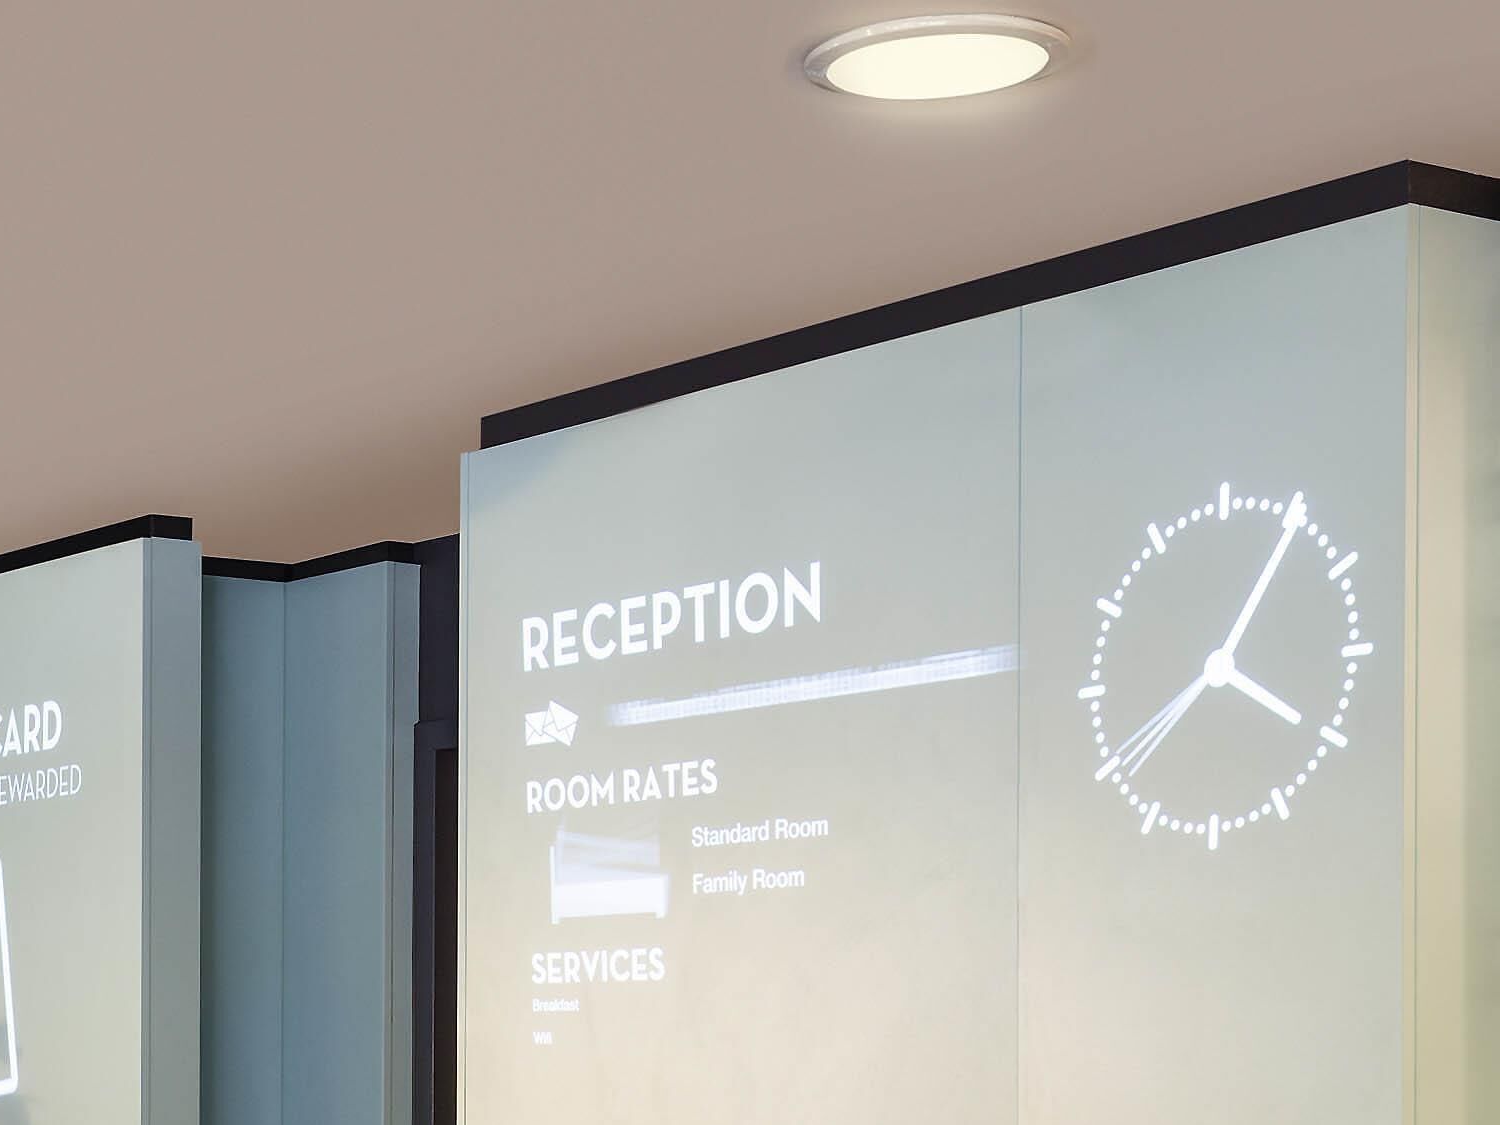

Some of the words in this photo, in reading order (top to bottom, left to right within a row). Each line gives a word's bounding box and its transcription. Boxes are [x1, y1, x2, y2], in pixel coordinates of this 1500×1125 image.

[522, 561, 822, 672] RECEPTION
[526, 771, 615, 814] ROOM
[623, 758, 718, 803] RATES
[691, 819, 770, 848] Standard
[775, 818, 829, 840] Room
[692, 870, 747, 895] Family
[752, 868, 805, 890] Room
[531, 946, 666, 985] SERVICES
